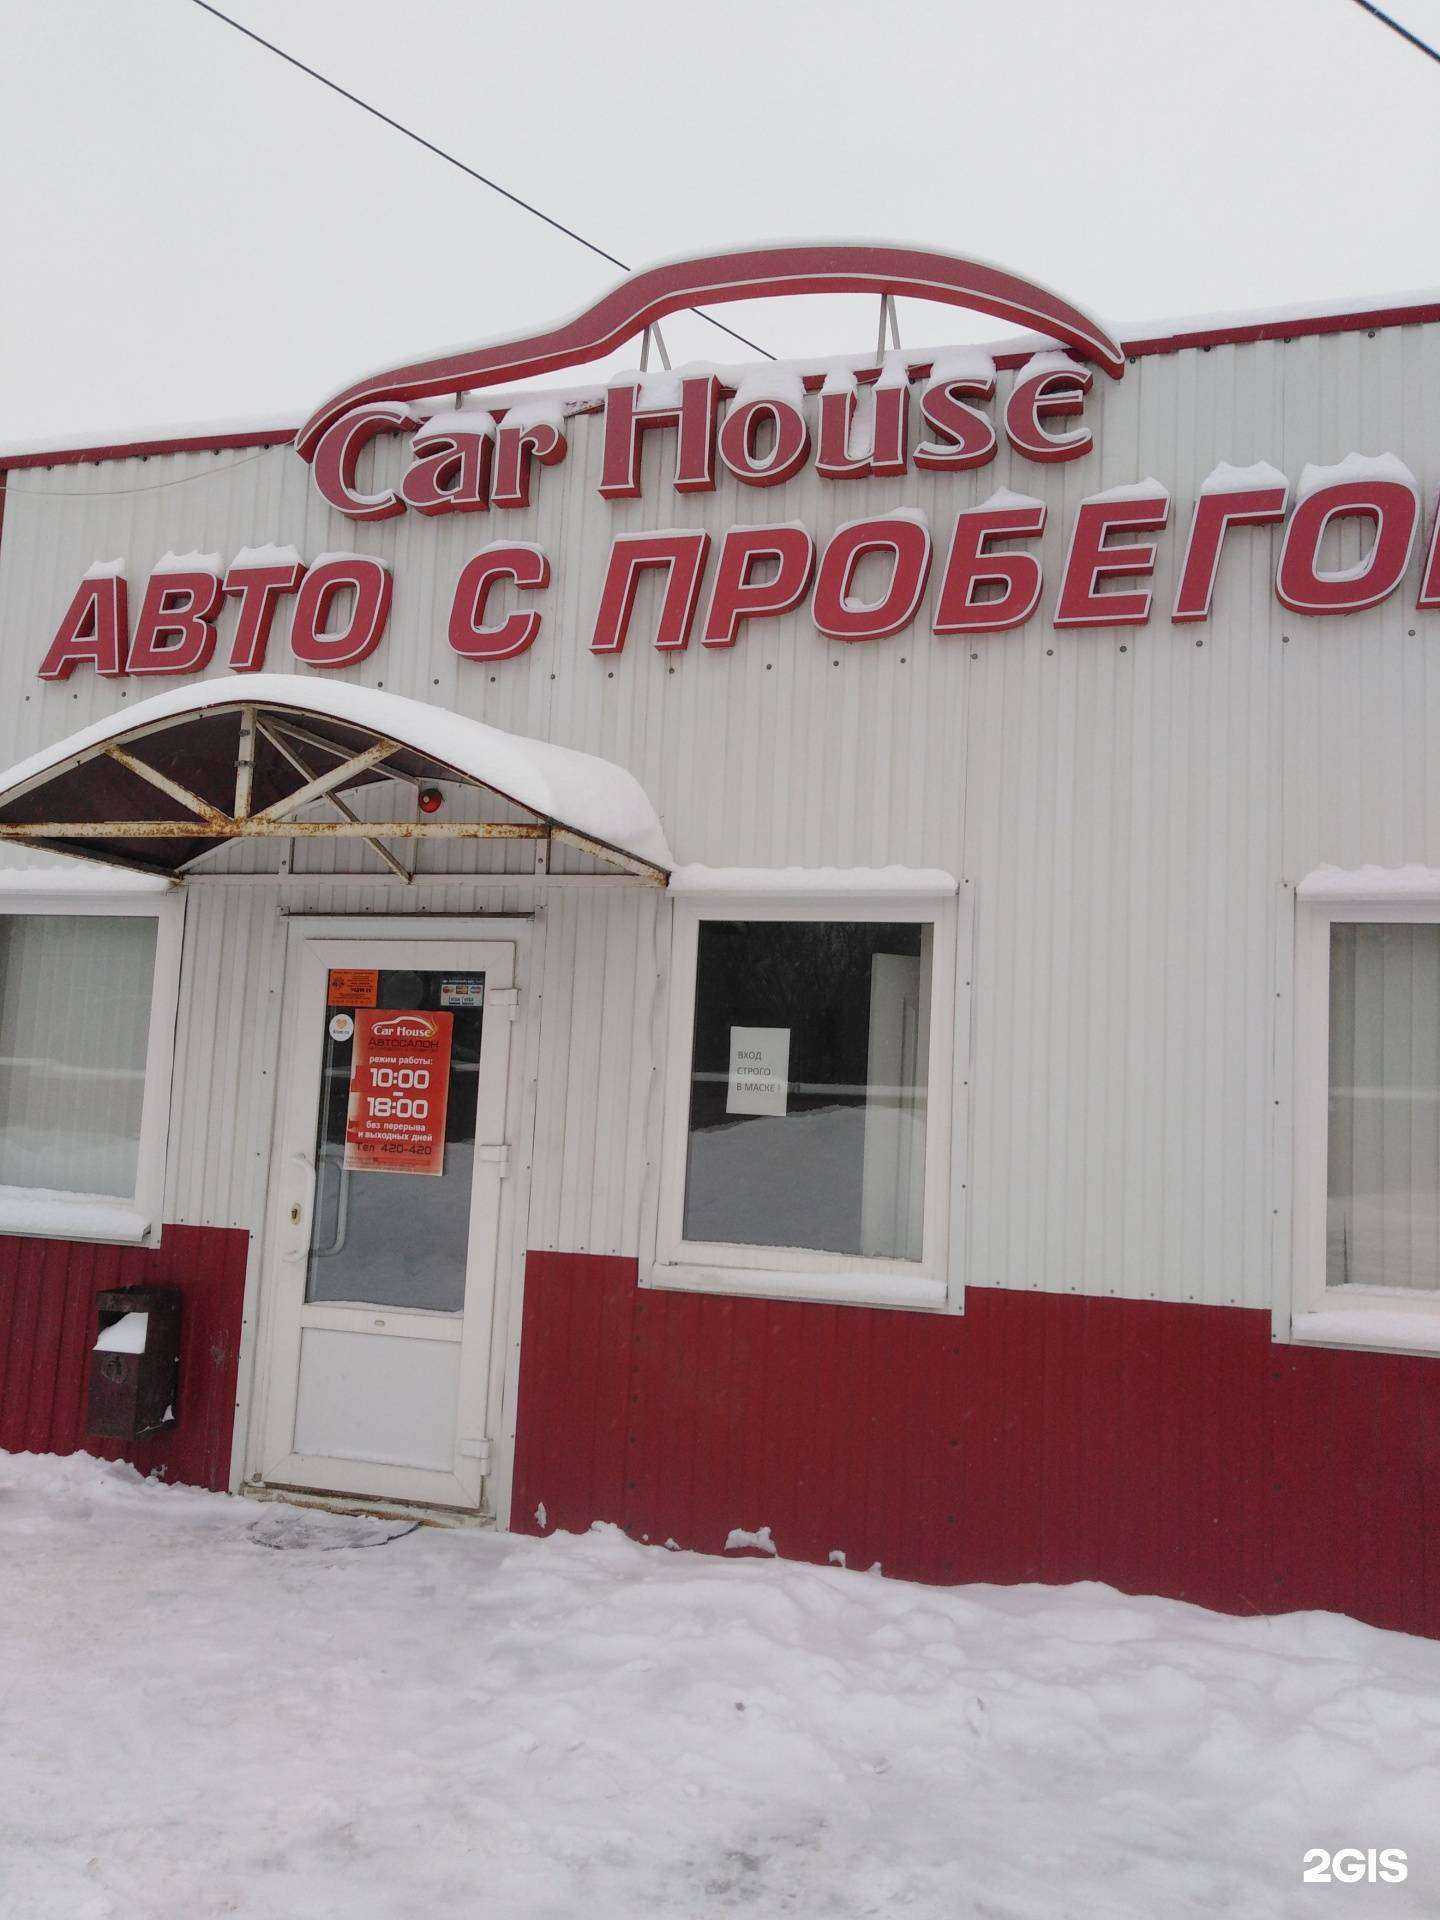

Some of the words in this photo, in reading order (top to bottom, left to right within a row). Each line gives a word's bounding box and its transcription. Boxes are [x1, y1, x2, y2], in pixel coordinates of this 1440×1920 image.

[311, 404, 567, 521] Car
[597, 367, 1094, 499] House
[37, 558, 393, 680] АВТО
[448, 546, 551, 662] С
[590, 479, 1440, 655] ПРОБЕГО
[373, 1025, 394, 1036] Car
[396, 1026, 433, 1038] House
[369, 1056, 397, 1065] режим
[737, 1051, 762, 1061] ВХОД
[736, 1066, 771, 1077] СТРОГО
[369, 1067, 430, 1090] 10:00
[736, 1082, 742, 1091] В
[366, 1097, 429, 1119] 18:00
[366, 1120, 381, 1129] без
[383, 1121, 426, 1132] перерыва
[364, 1131, 409, 1142] выходных
[411, 1131, 433, 1142] дней
[380, 1143, 432, 1156] 420-420
